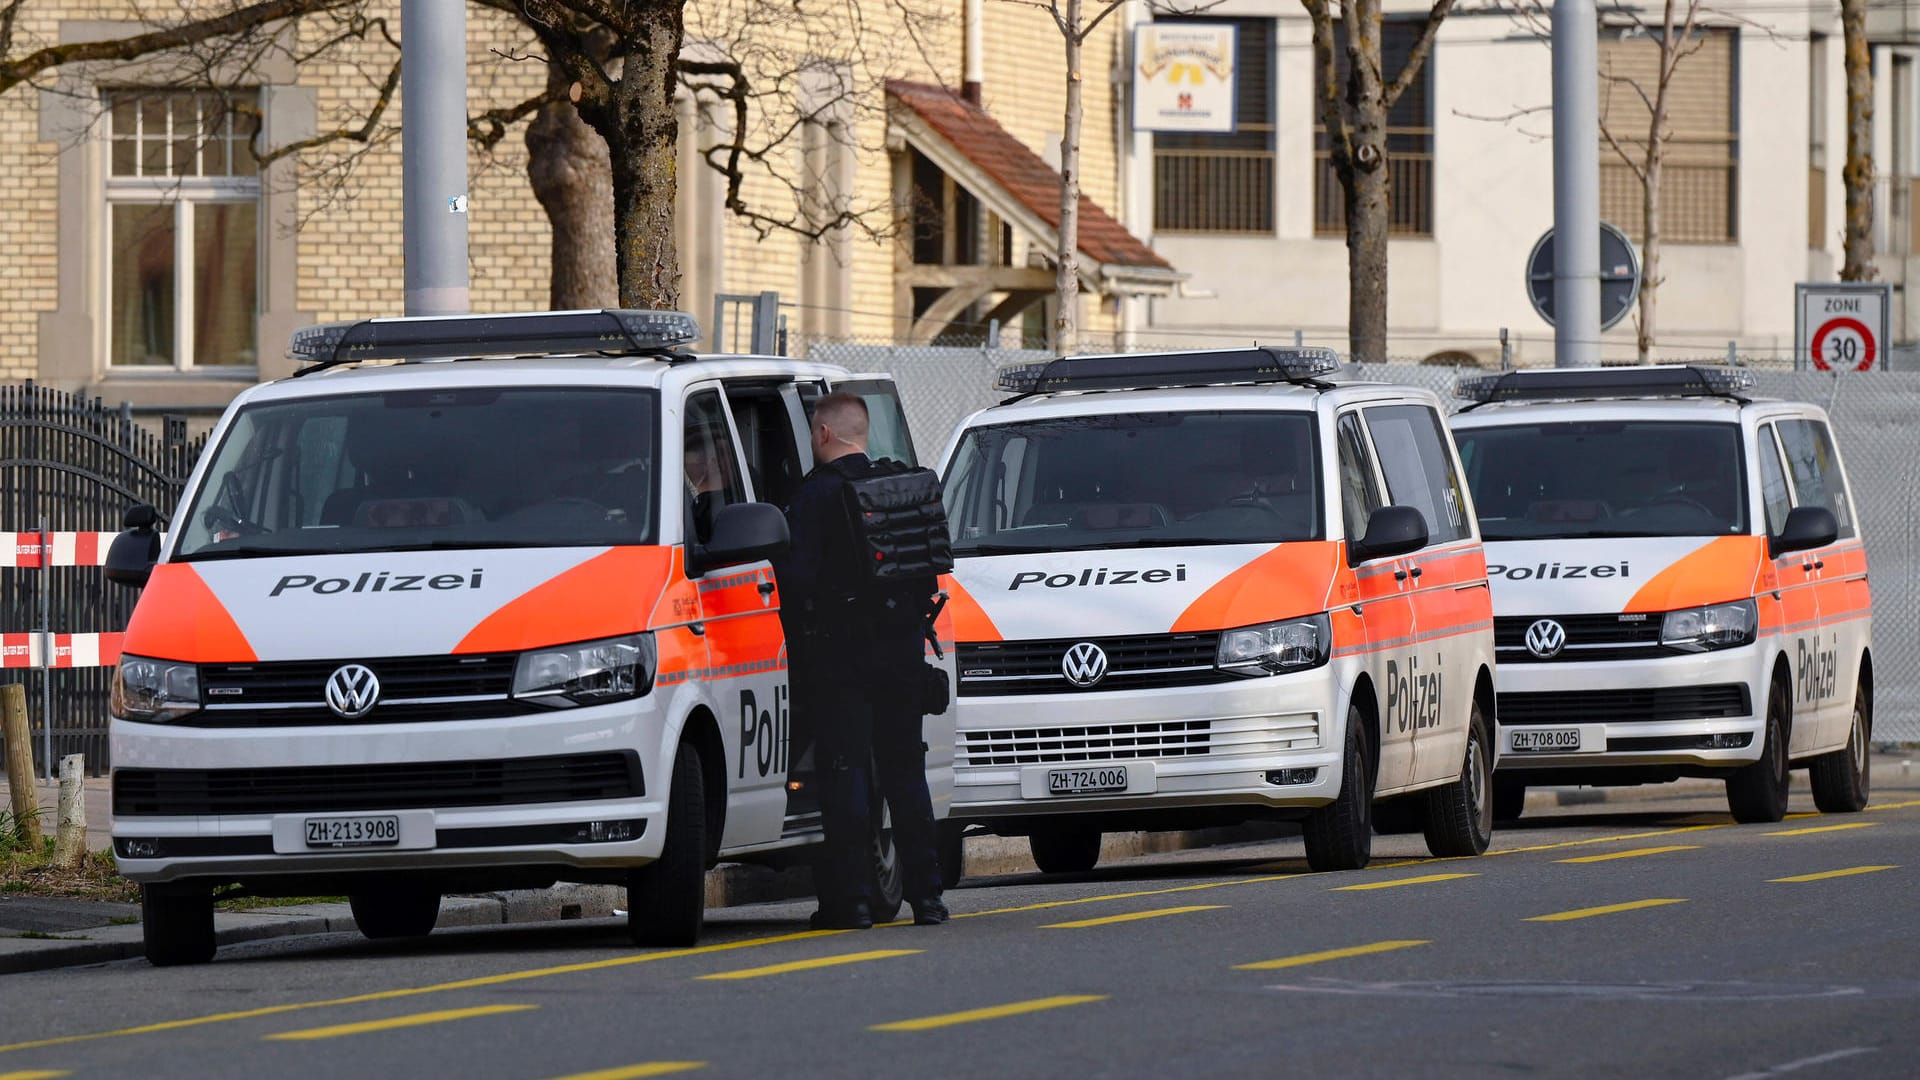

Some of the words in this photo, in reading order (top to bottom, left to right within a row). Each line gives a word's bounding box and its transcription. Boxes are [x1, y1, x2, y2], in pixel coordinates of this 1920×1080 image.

[1824, 298, 1861, 312] ZONE
[1831, 337, 1856, 362] 30
[269, 568, 483, 597] Polizei
[1008, 564, 1186, 590] Polizei
[1526, 619, 1565, 657] VW
[1063, 643, 1107, 686] VW
[1797, 633, 1837, 704] Polizei
[327, 665, 378, 717] VW
[1386, 653, 1442, 734] Polizei
[739, 685, 788, 779] Poli
[1556, 731, 1578, 745] 005
[1099, 770, 1124, 786] 006
[365, 820, 396, 839] 908
